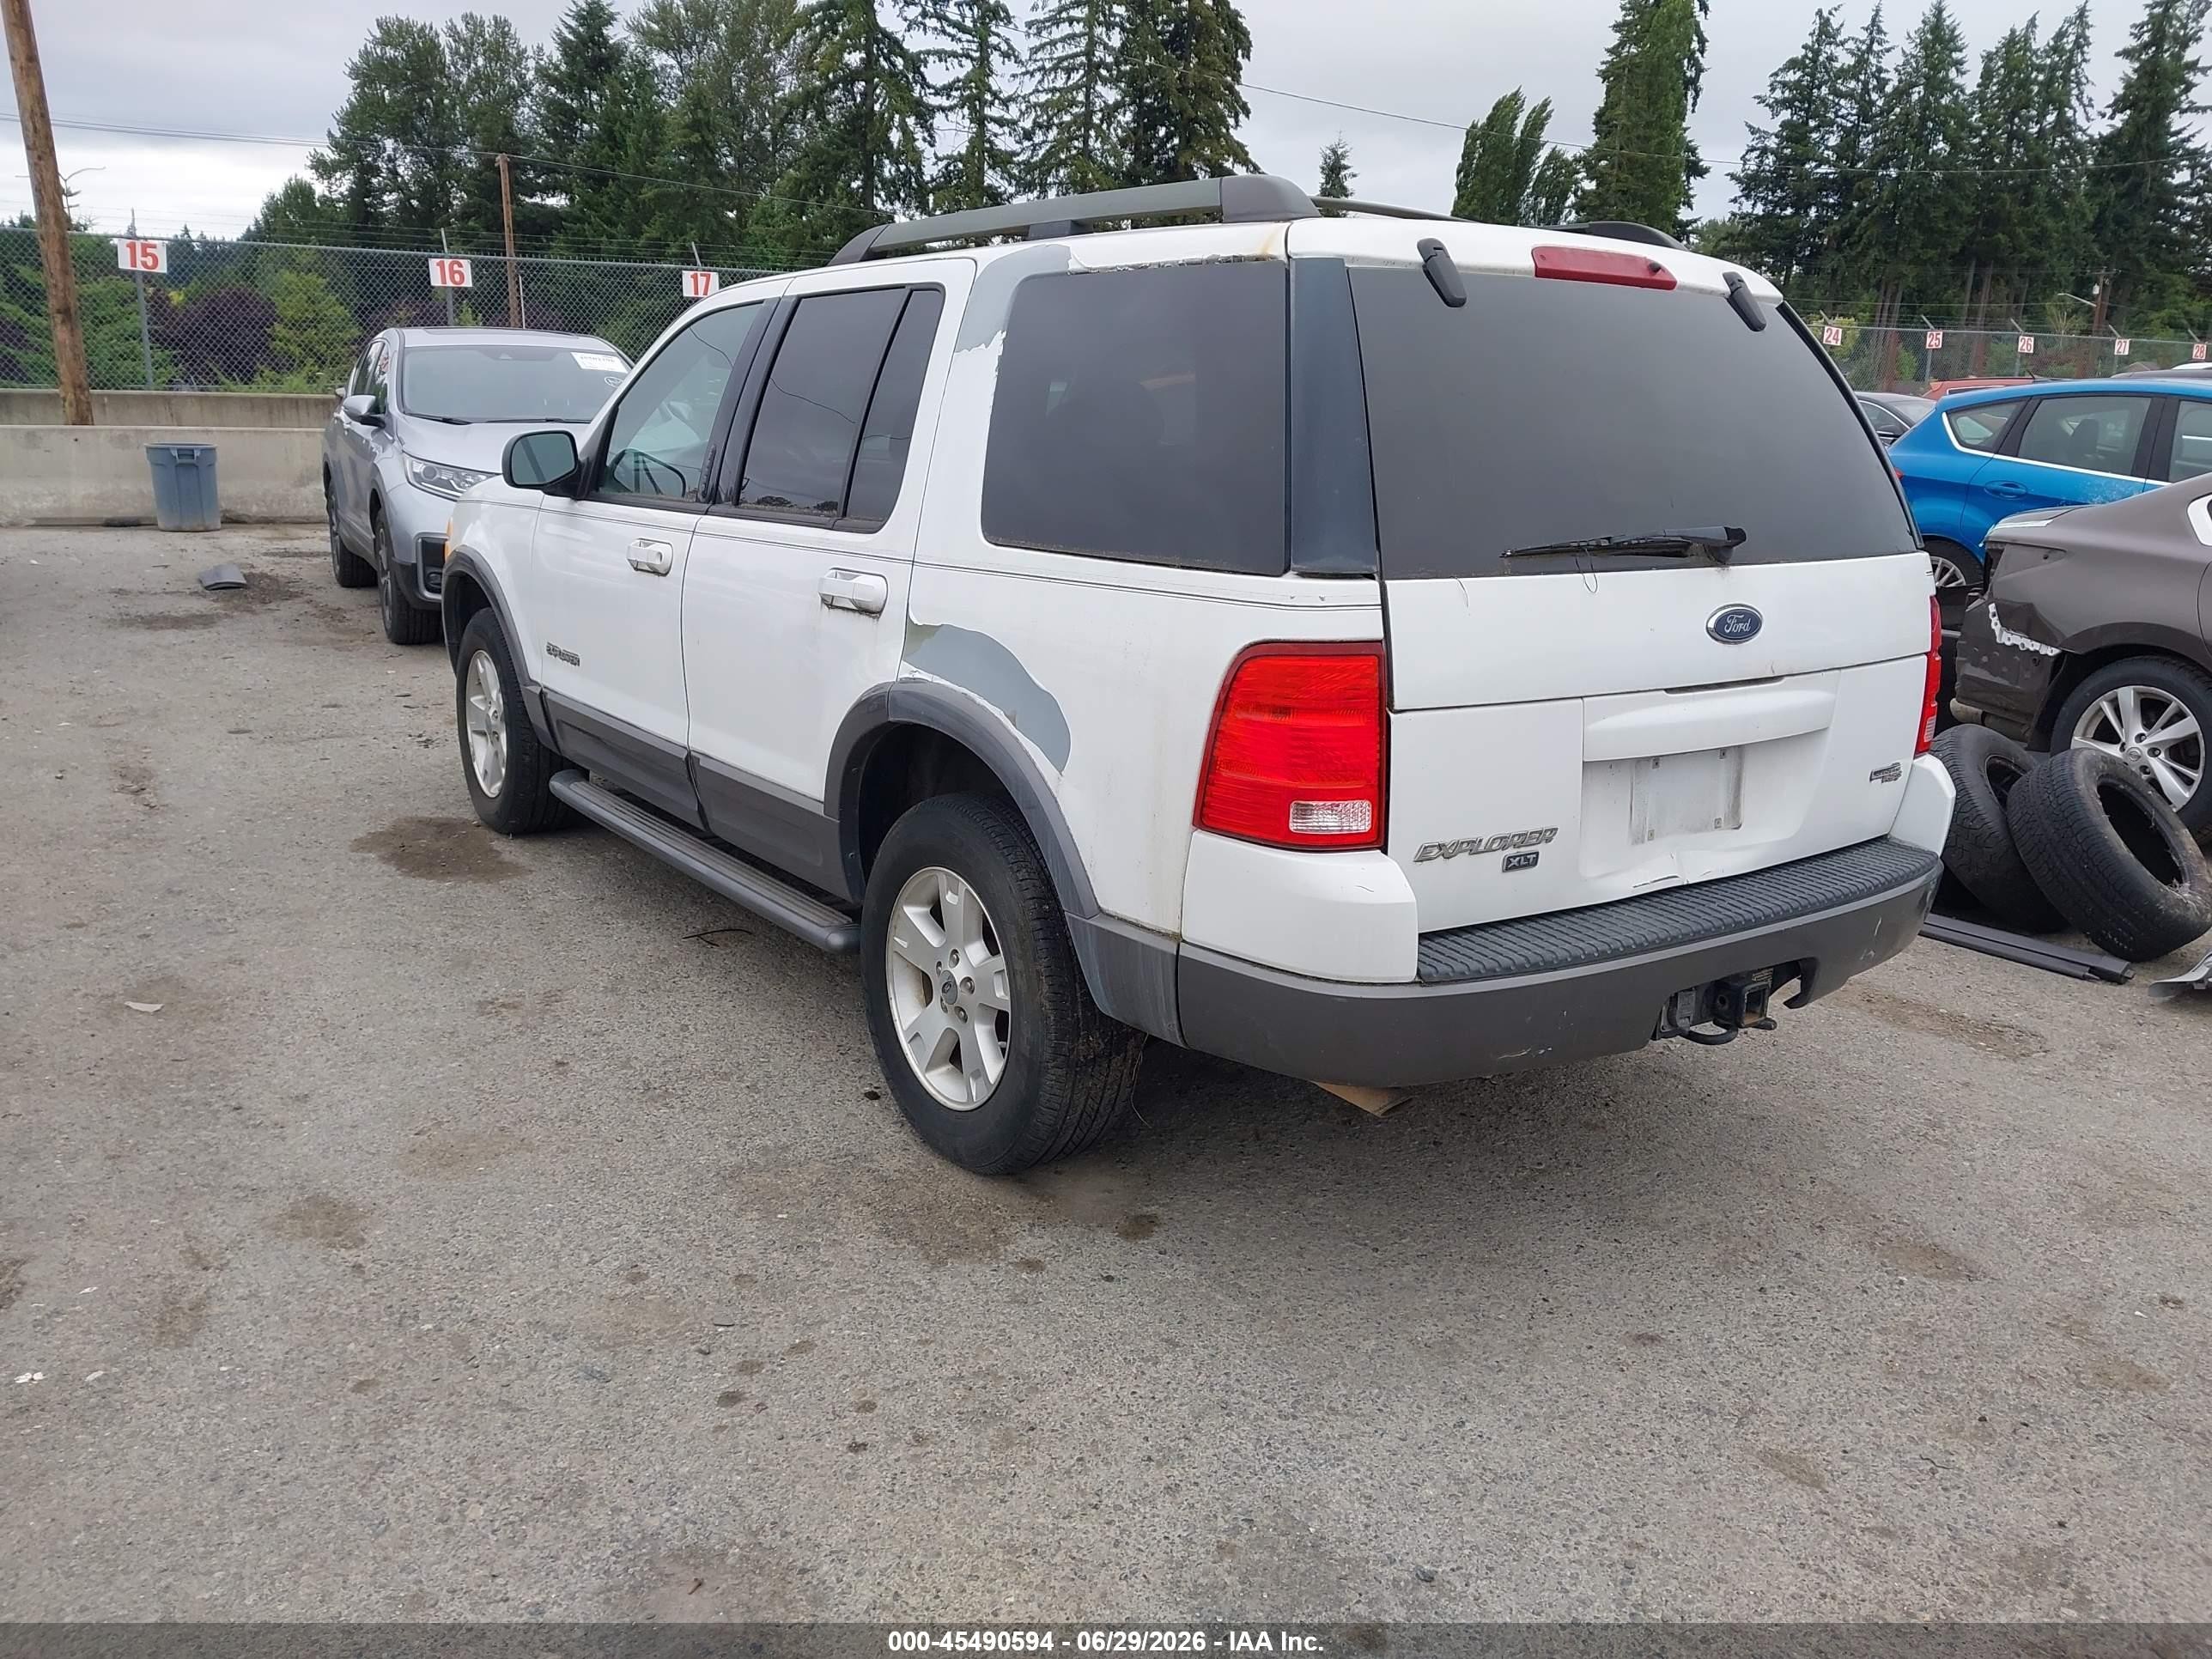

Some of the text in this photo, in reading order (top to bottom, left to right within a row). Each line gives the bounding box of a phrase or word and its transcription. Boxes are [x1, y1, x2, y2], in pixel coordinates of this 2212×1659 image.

[126, 241, 159, 270] 15
[436, 260, 465, 285] 16
[690, 273, 711, 295] 17
[1826, 328, 1840, 344] 24
[1928, 332, 1942, 348] 25
[2020, 337, 2033, 352] 26
[2116, 340, 2129, 354] 27
[2194, 345, 2205, 359] 28
[1724, 614, 1751, 633] Ford
[1413, 827, 1559, 862] EXPLORER
[1507, 854, 1538, 869] XLT
